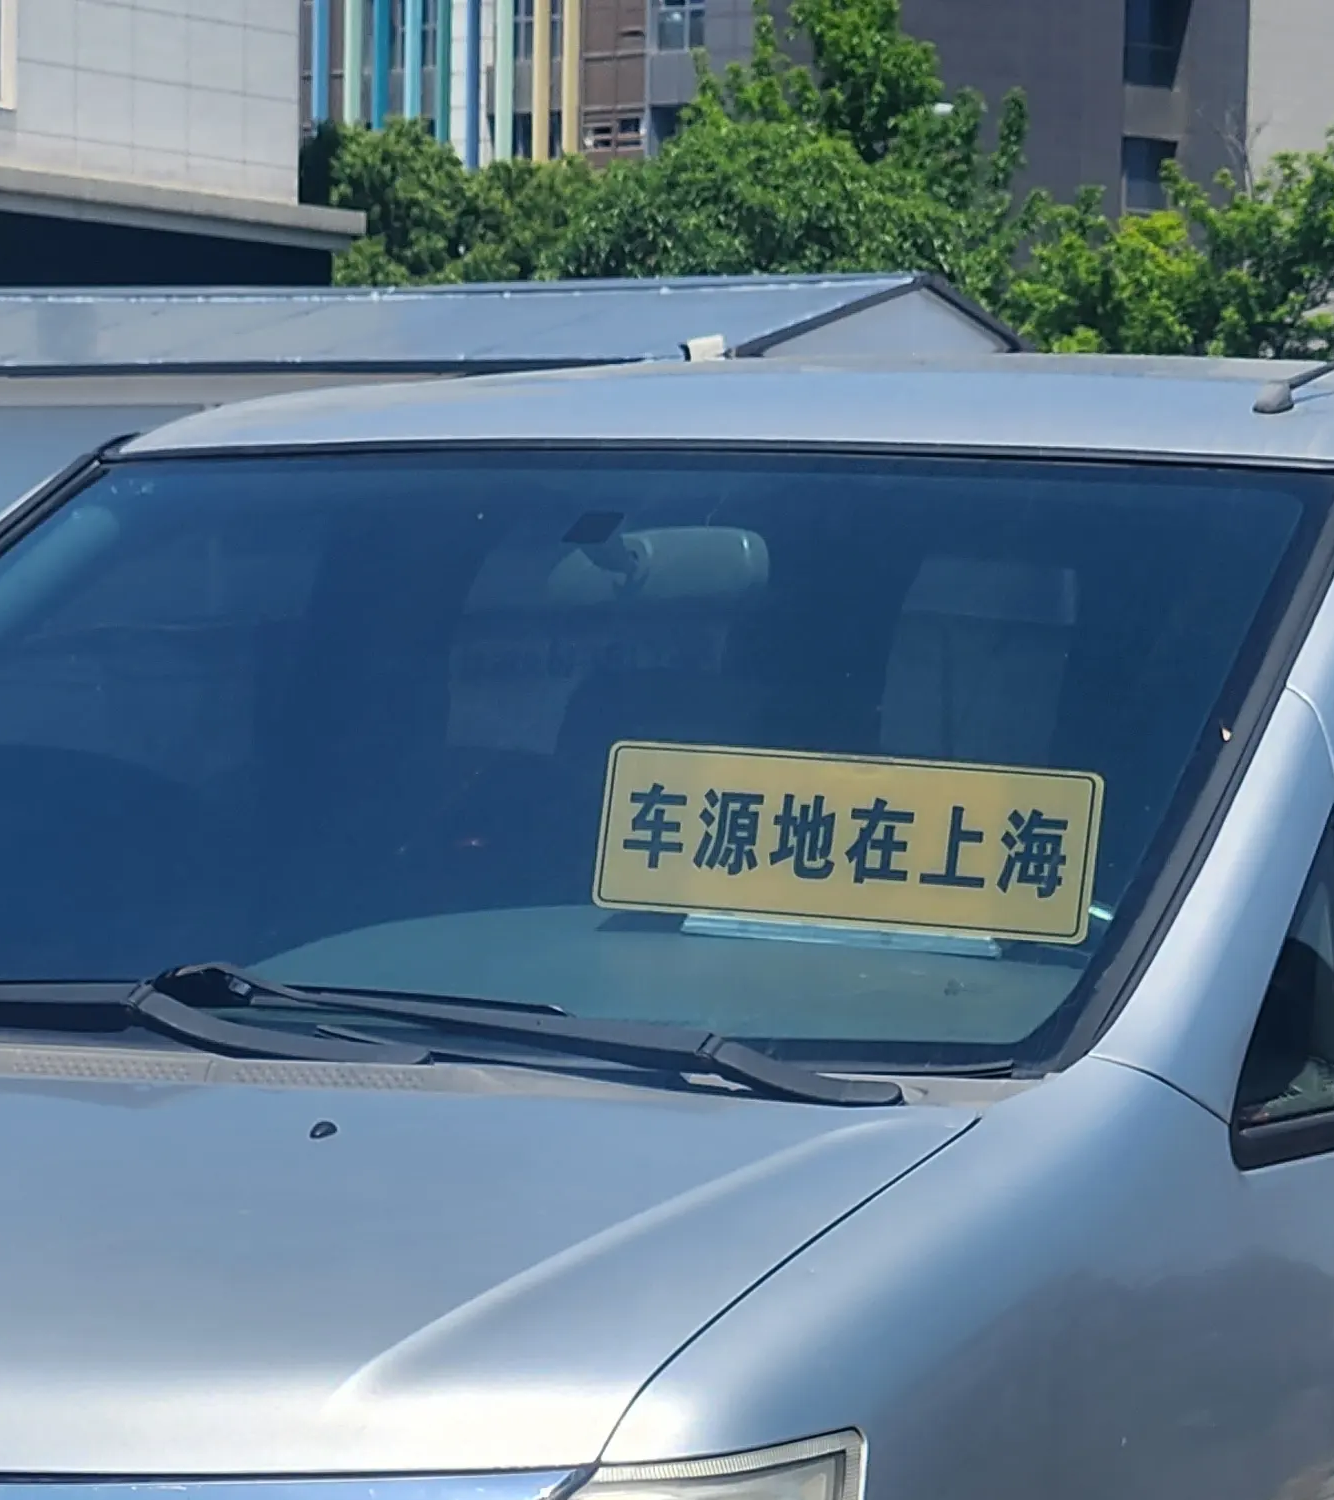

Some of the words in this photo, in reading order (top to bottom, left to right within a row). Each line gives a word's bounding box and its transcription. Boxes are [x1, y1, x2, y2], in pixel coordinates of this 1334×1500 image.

[622, 782, 1069, 899] 车源地在上海
